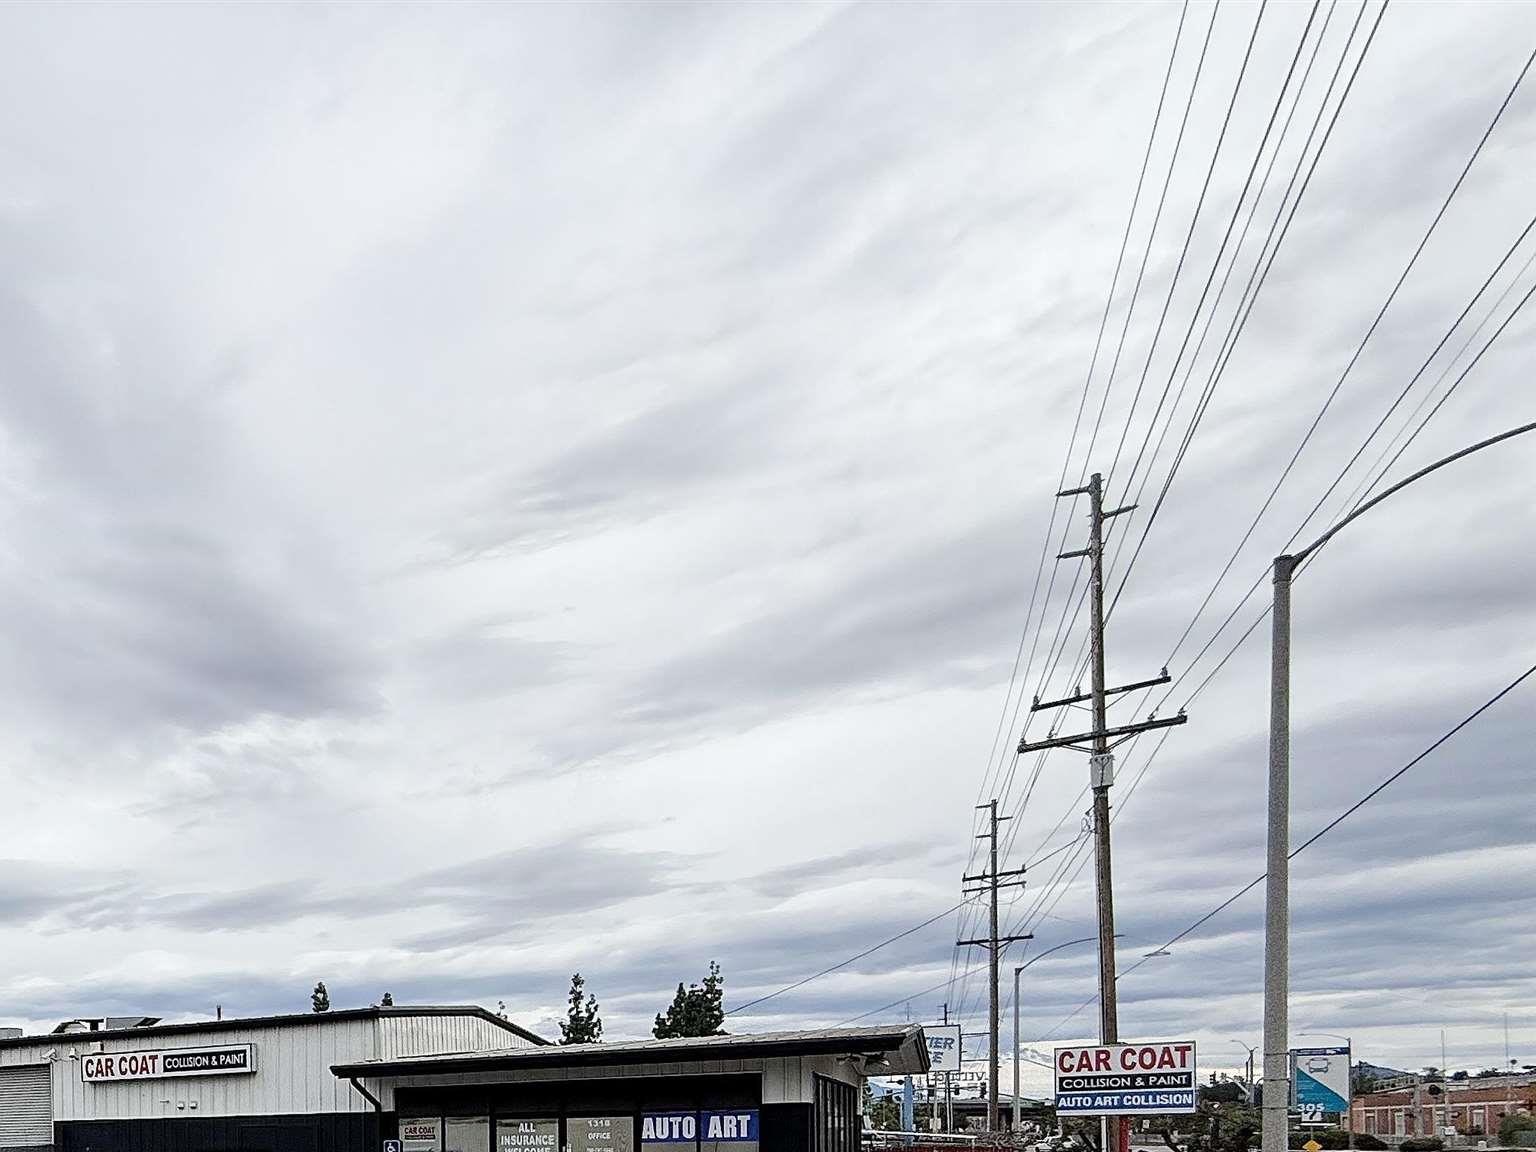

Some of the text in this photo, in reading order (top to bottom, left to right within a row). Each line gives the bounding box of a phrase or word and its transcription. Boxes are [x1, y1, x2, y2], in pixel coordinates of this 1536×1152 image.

[85, 1053, 245, 1078] CAR COAT COLLISION & PAINT
[1058, 1046, 1192, 1073] CAR COAT
[1063, 1075, 1187, 1089] COLLISION & PAINT
[1058, 1093, 1192, 1107] AUTO ART COLLISION
[418, 1126, 435, 1134] COAT
[518, 1122, 536, 1133] ALL
[641, 1115, 750, 1139] AUTO ART
[500, 1134, 555, 1145] INSURANCE
[588, 1132, 611, 1140] OFFICE
